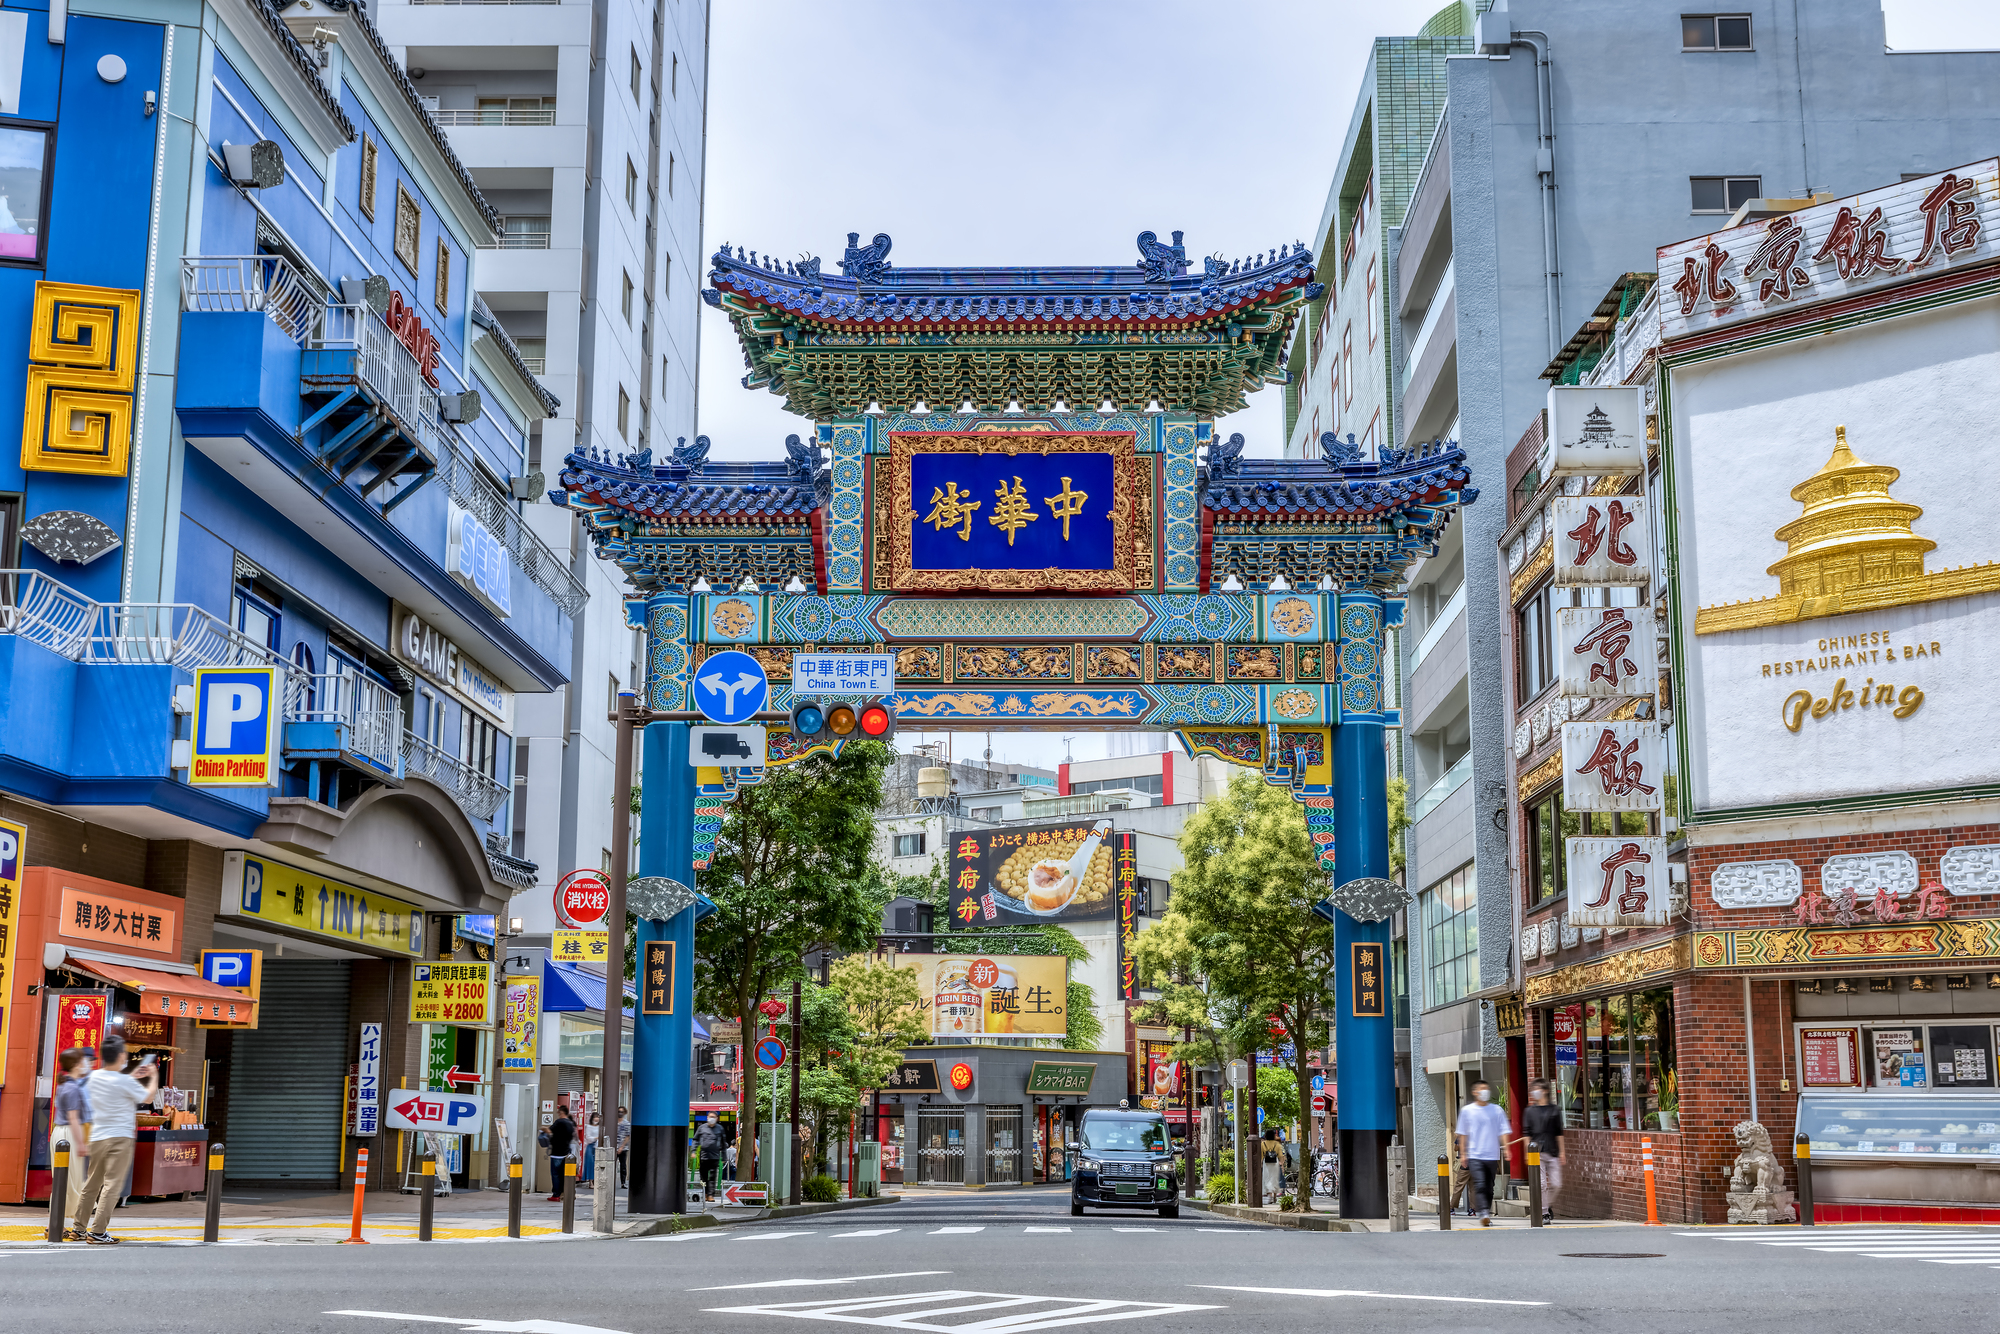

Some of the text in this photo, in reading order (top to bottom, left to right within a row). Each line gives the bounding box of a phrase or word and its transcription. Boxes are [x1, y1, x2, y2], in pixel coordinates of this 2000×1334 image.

[1673, 174, 1982, 317] 北京飯店
[386, 290, 440, 389] GAME
[458, 509, 511, 618] SEGA
[404, 614, 457, 687] GAME
[1818, 630, 1890, 651] CHINESE
[800, 659, 887, 677] 中華街東門
[1762, 641, 1941, 677] RESTAURANT & BAR
[462, 660, 473, 694] by
[807, 679, 879, 689] China Town E.
[205, 683, 262, 748] P
[1782, 677, 1925, 733] Peking
[195, 759, 265, 779] China Parking
[989, 835, 1024, 848] ようこそ
[245, 865, 261, 908] P
[956, 839, 981, 920] 王府井
[332, 889, 355, 935] IN
[567, 891, 606, 909] 消火栓
[1793, 881, 1948, 928] 北京飯店
[75, 901, 162, 941] 聘珍大甘栗
[410, 914, 422, 949] P
[212, 956, 243, 983] P
[415, 966, 430, 980] P
[431, 966, 487, 980] 時間貸駐車場
[650, 947, 667, 1005] 朝陽門
[973, 963, 995, 984] 新
[1359, 949, 1377, 1007] 朝陽門
[75, 1004, 90, 1012] We
[528, 984, 537, 1017] チャイナで
[937, 994, 980, 1004] KIRIN BEER
[941, 1007, 975, 1016] 一番搾り
[990, 985, 1063, 1015] 誕生。
[359, 1025, 380, 1101] ハイルーフ車
[505, 1058, 533, 1068] SEGA
[886, 1067, 921, 1085] 陽軒
[1036, 1074, 1087, 1088] シウマイBAR
[359, 1106, 378, 1132] 空車
[406, 1101, 442, 1120] 入口
[447, 1101, 477, 1126] P
